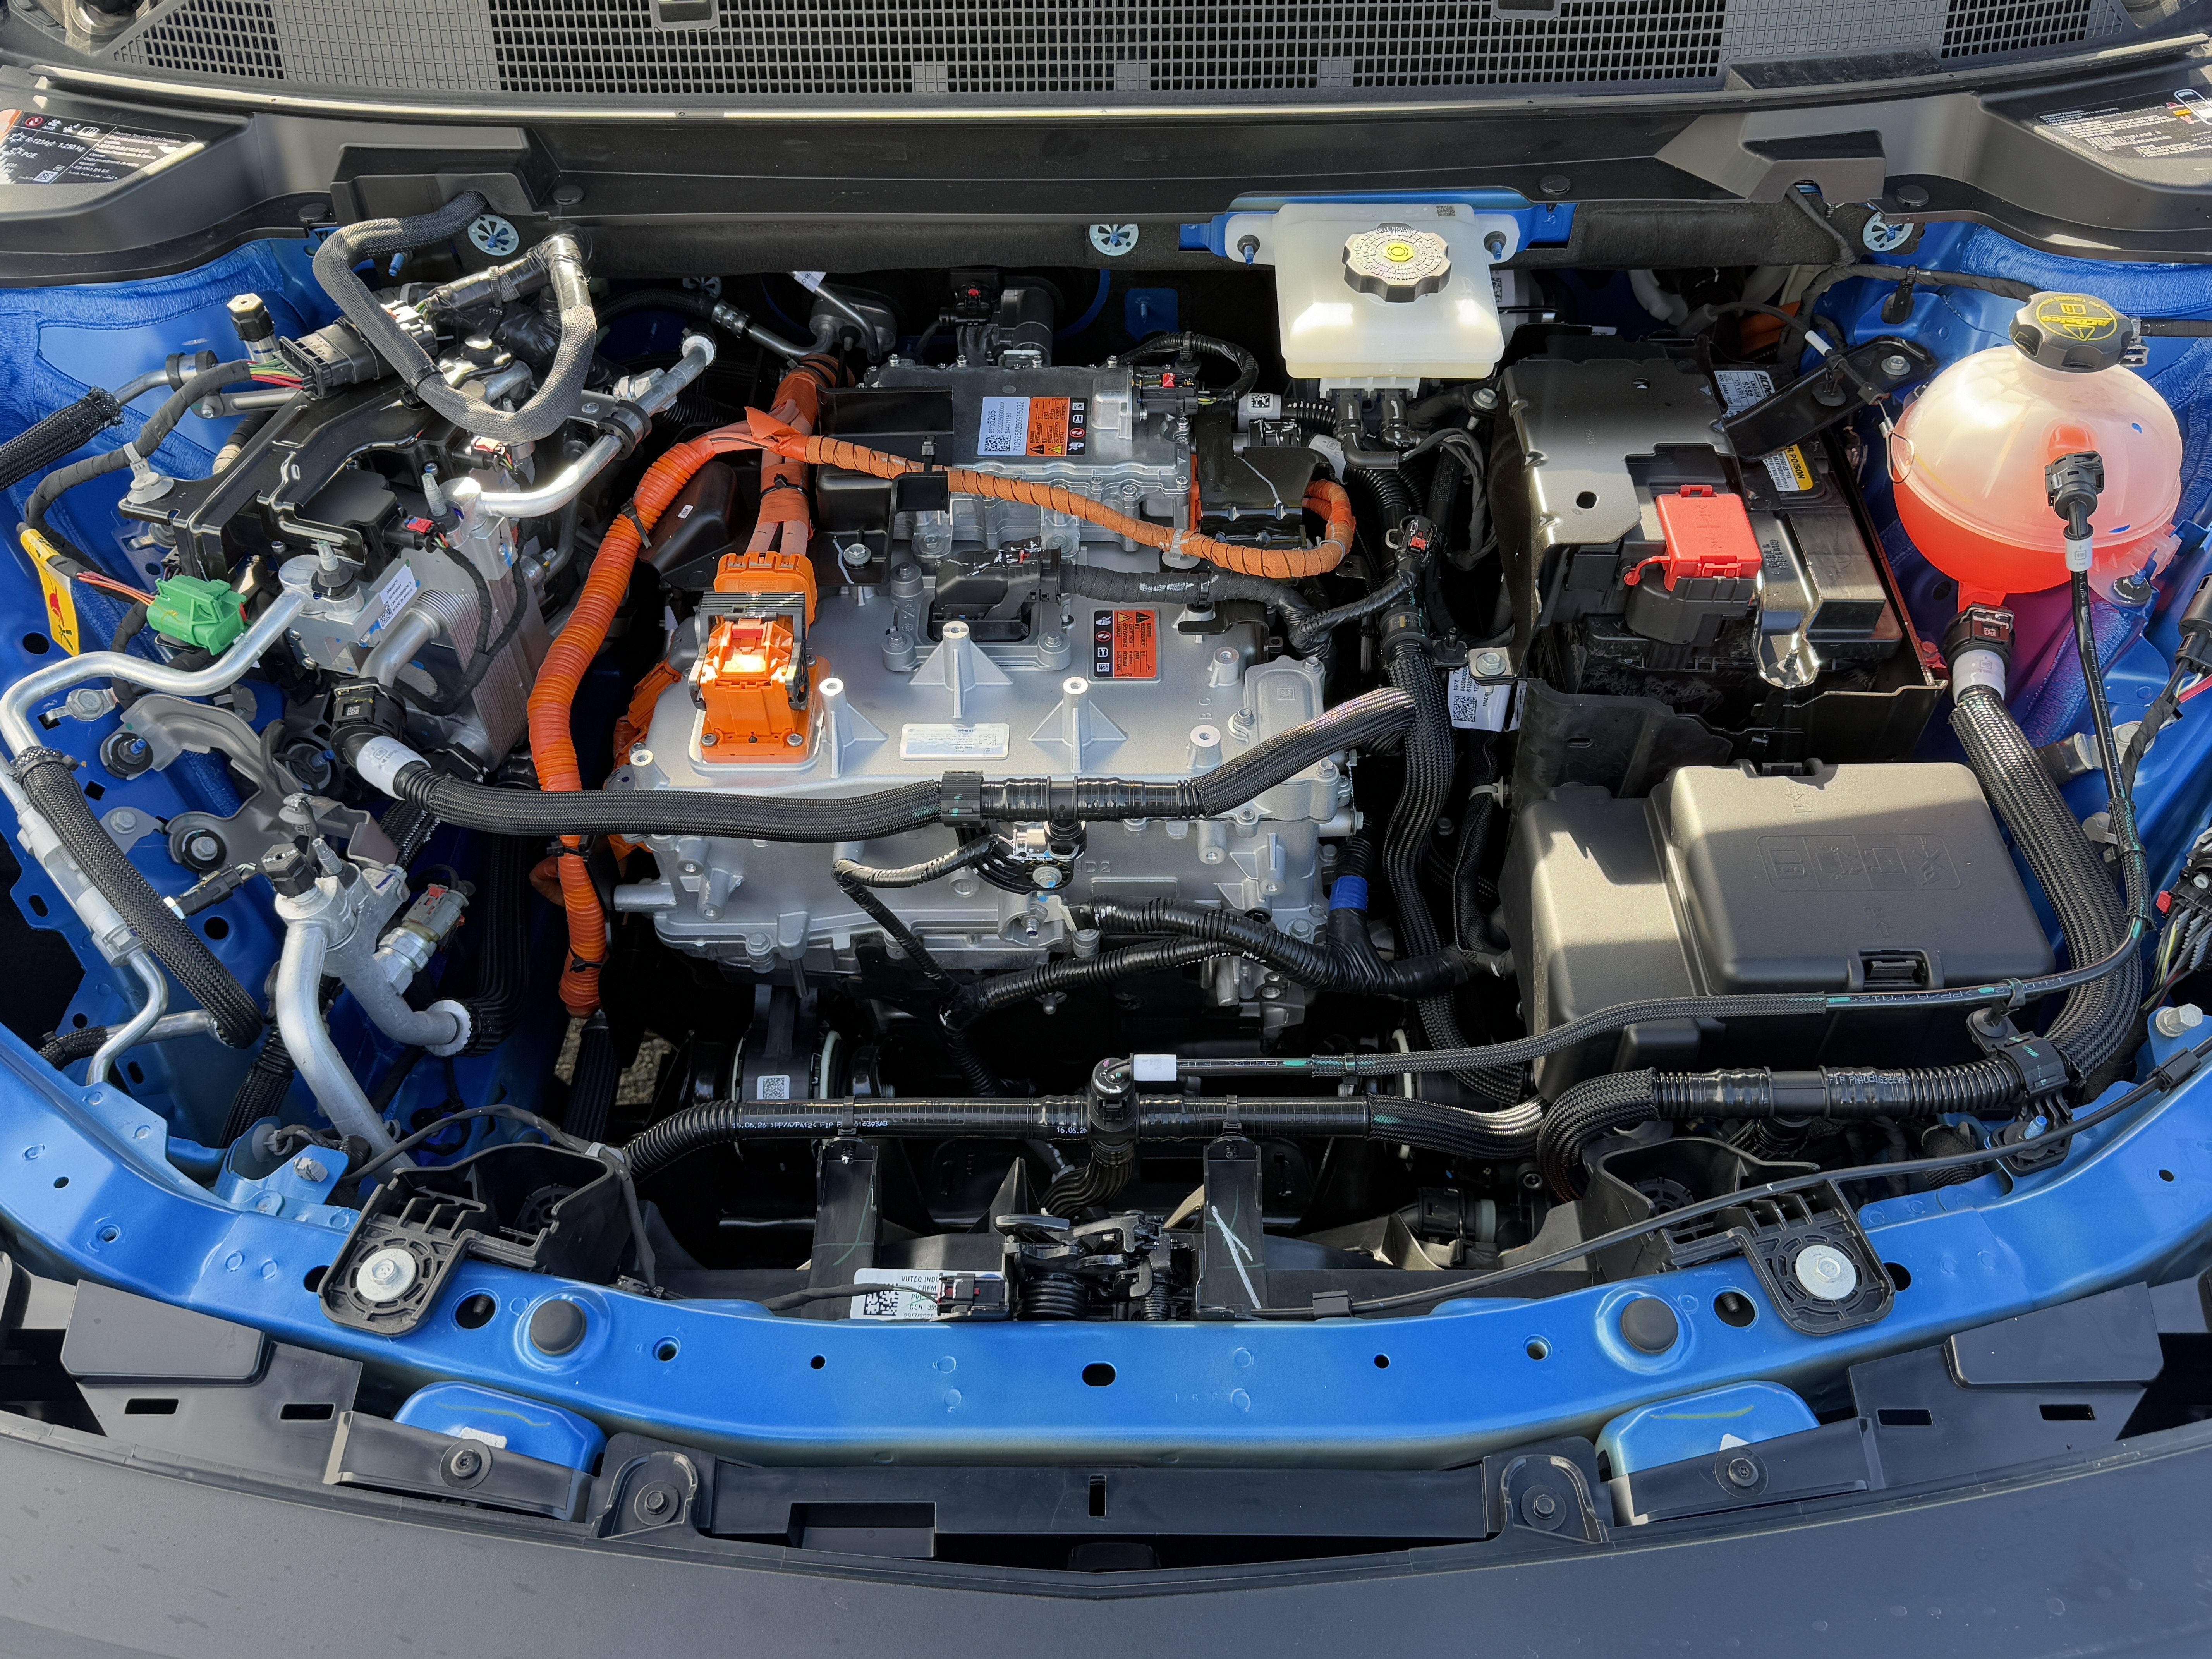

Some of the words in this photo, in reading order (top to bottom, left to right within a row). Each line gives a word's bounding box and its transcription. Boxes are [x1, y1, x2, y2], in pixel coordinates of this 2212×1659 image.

[2041, 316, 2111, 326] ACDelco
[1742, 382, 1753, 397] 9352
[1829, 1075, 1844, 1084] FIP
[1057, 1126, 1087, 1134] 16.06.26
